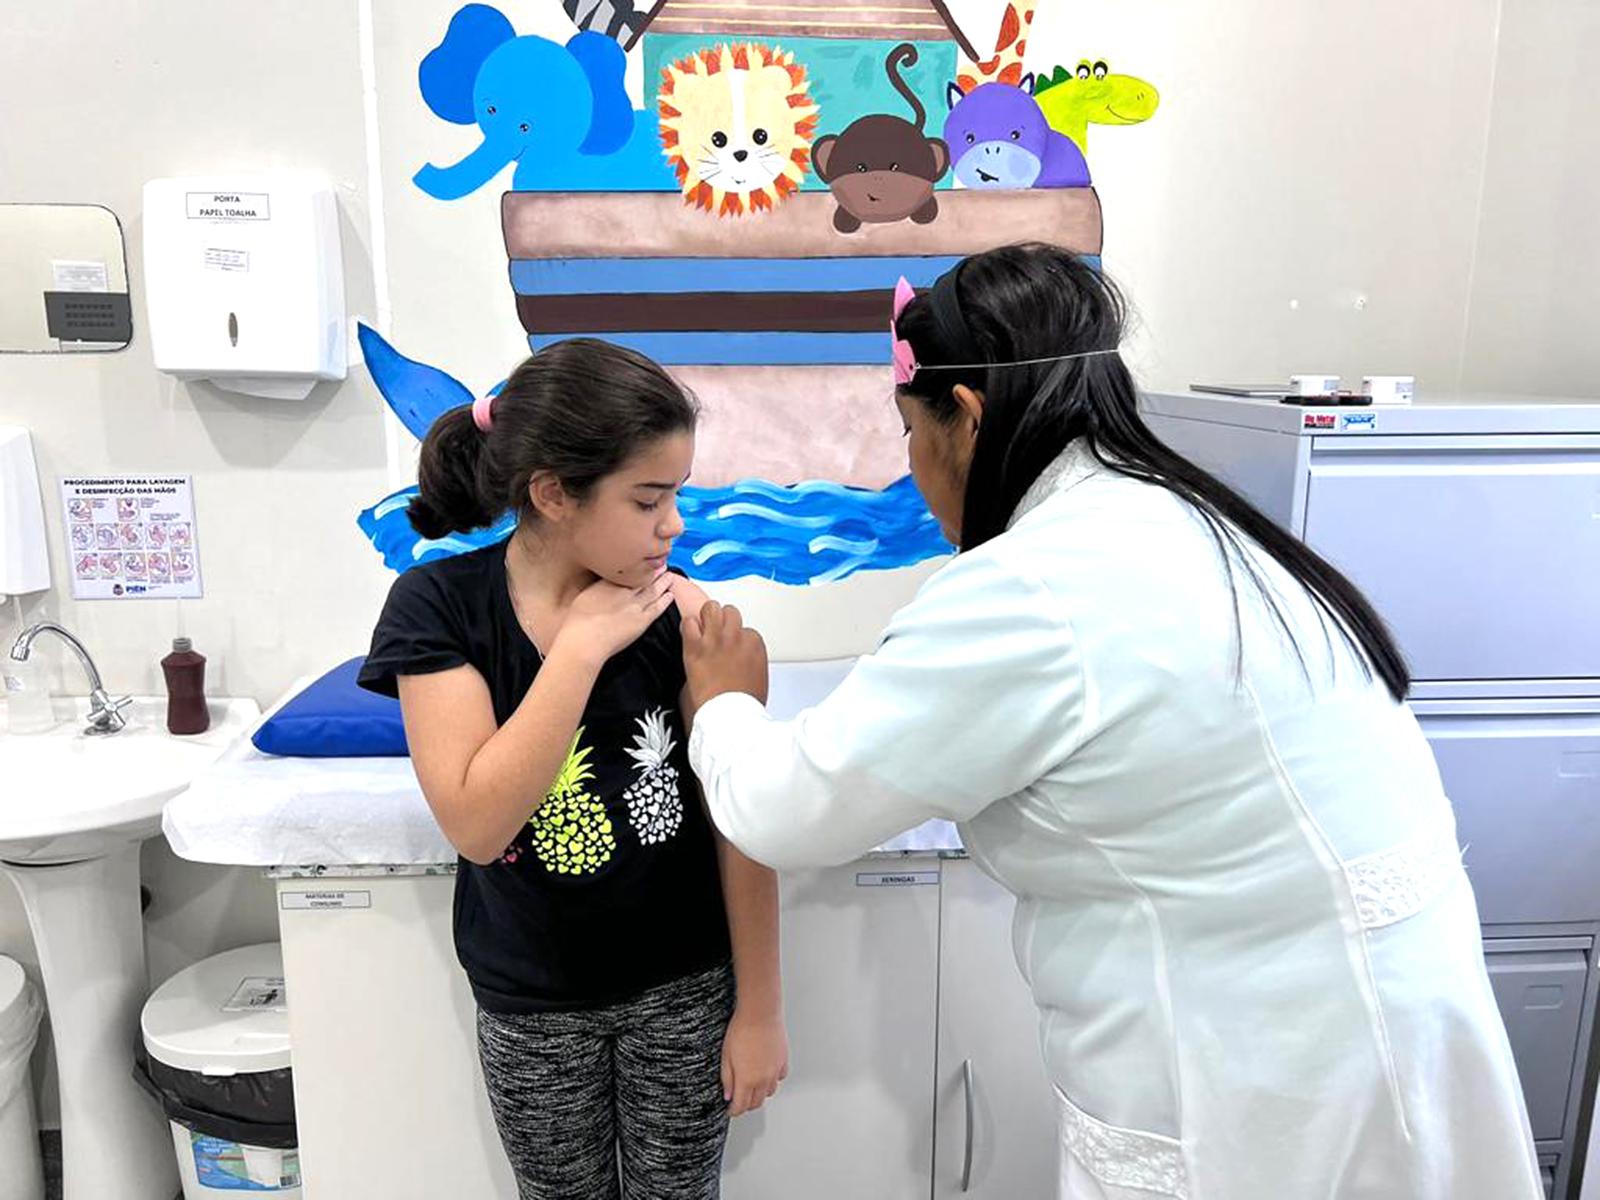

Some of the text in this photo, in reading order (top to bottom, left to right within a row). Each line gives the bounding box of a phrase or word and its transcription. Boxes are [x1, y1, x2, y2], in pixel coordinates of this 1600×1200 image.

[213, 195, 241, 203] PORTA
[199, 208, 257, 217] PAPEL TOALHA
[82, 486, 135, 495] DESINFECÇÃO
[136, 487, 153, 495] DAS
[154, 486, 177, 494] MÃOS
